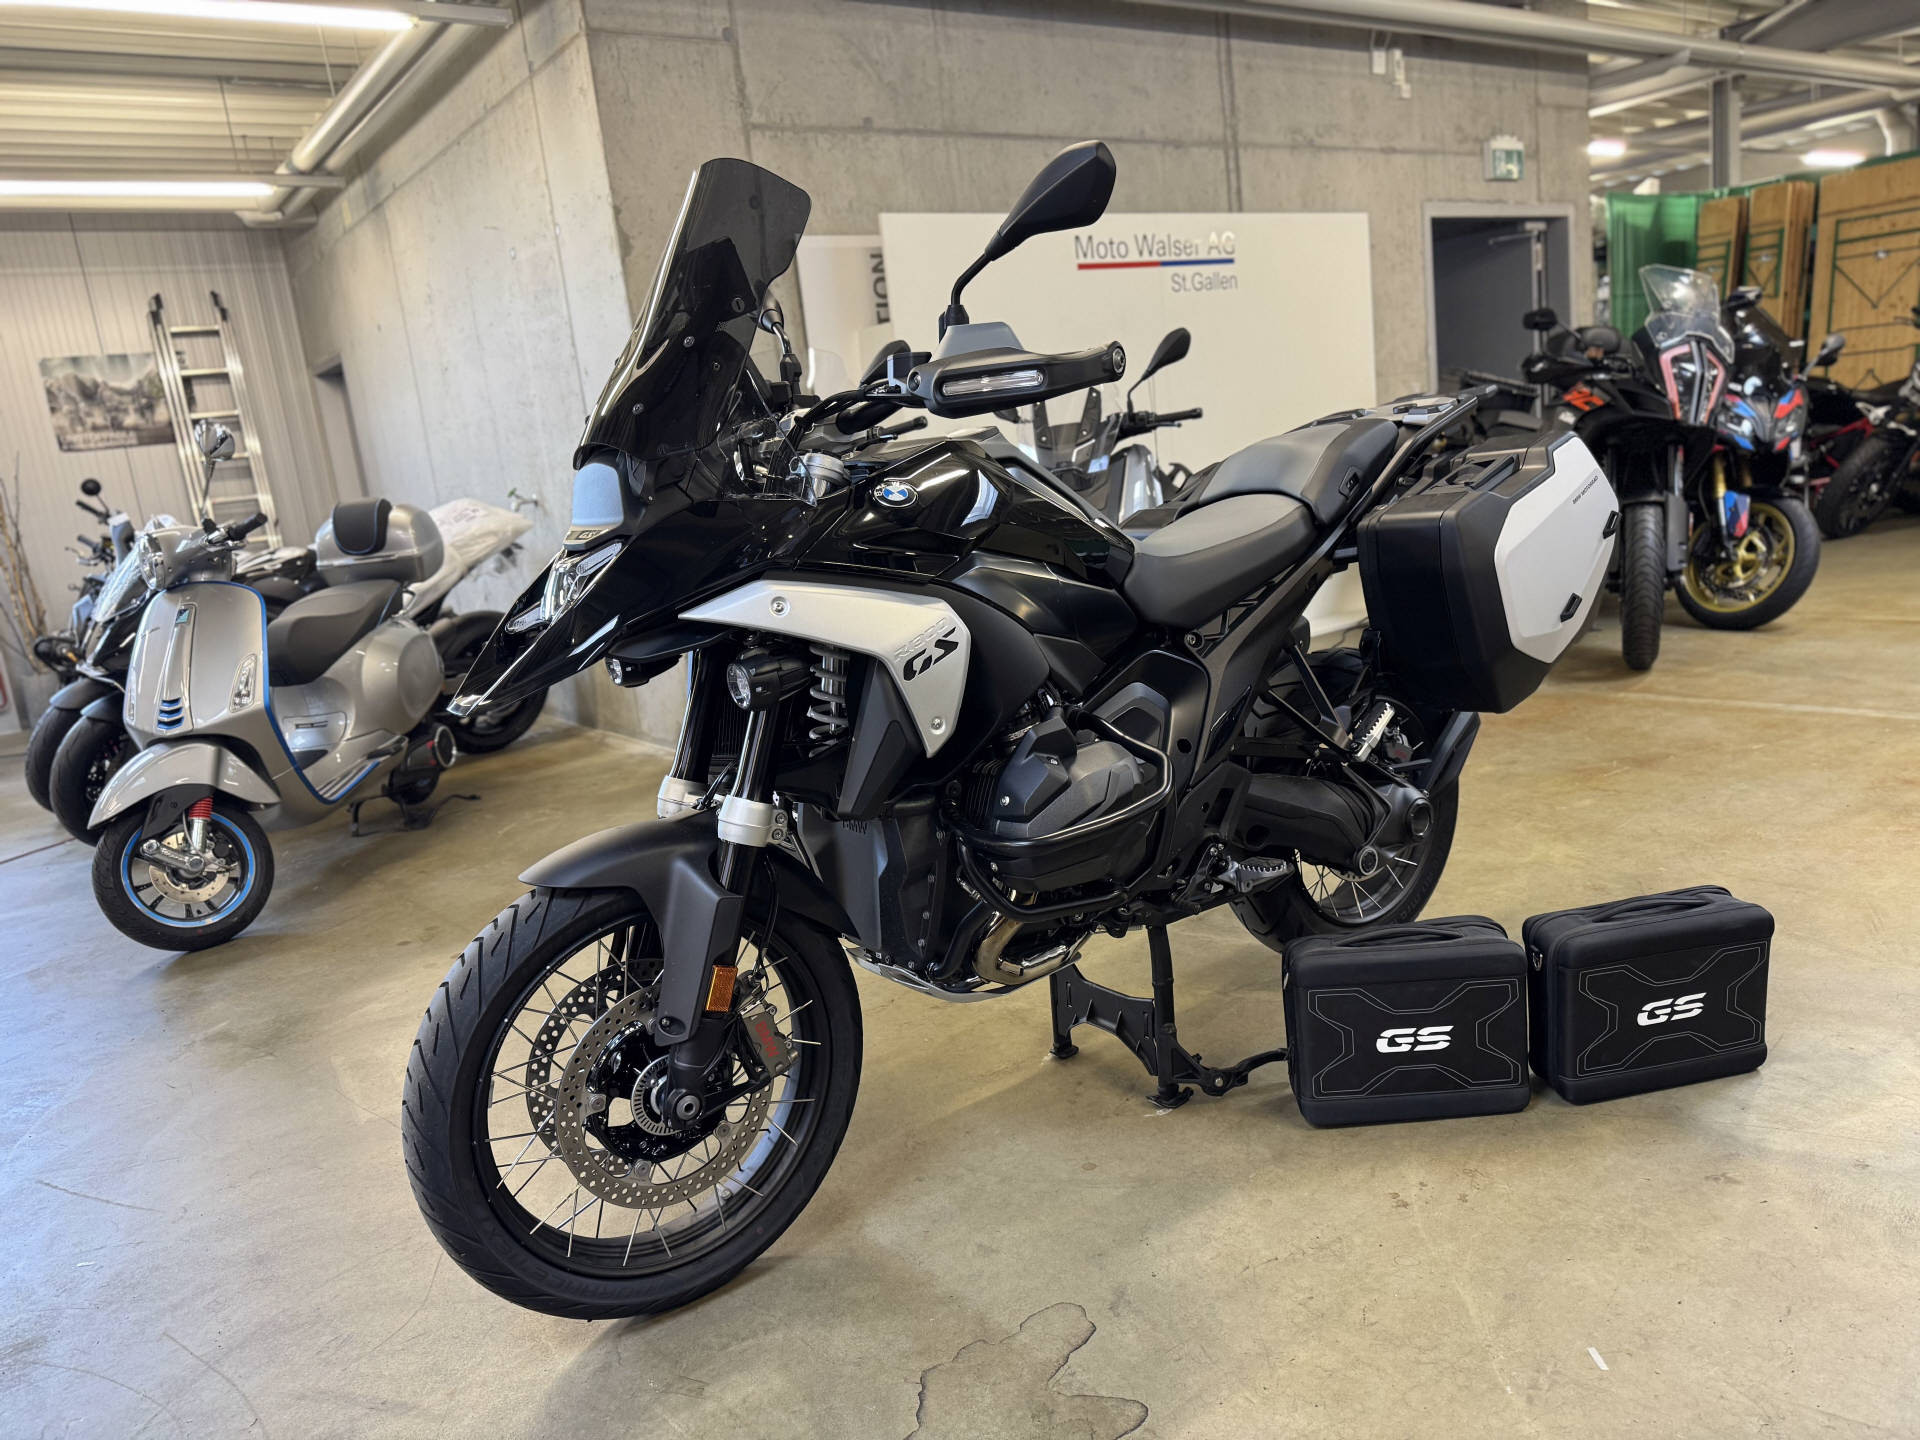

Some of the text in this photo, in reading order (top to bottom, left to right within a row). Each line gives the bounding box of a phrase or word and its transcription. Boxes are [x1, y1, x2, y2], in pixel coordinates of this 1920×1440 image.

[1074, 231, 1236, 260] Moto Walser AG
[903, 626, 959, 681] GS
[1637, 991, 1708, 1027] GS
[754, 1020, 780, 1058] BMW
[1375, 1025, 1455, 1054] GS
